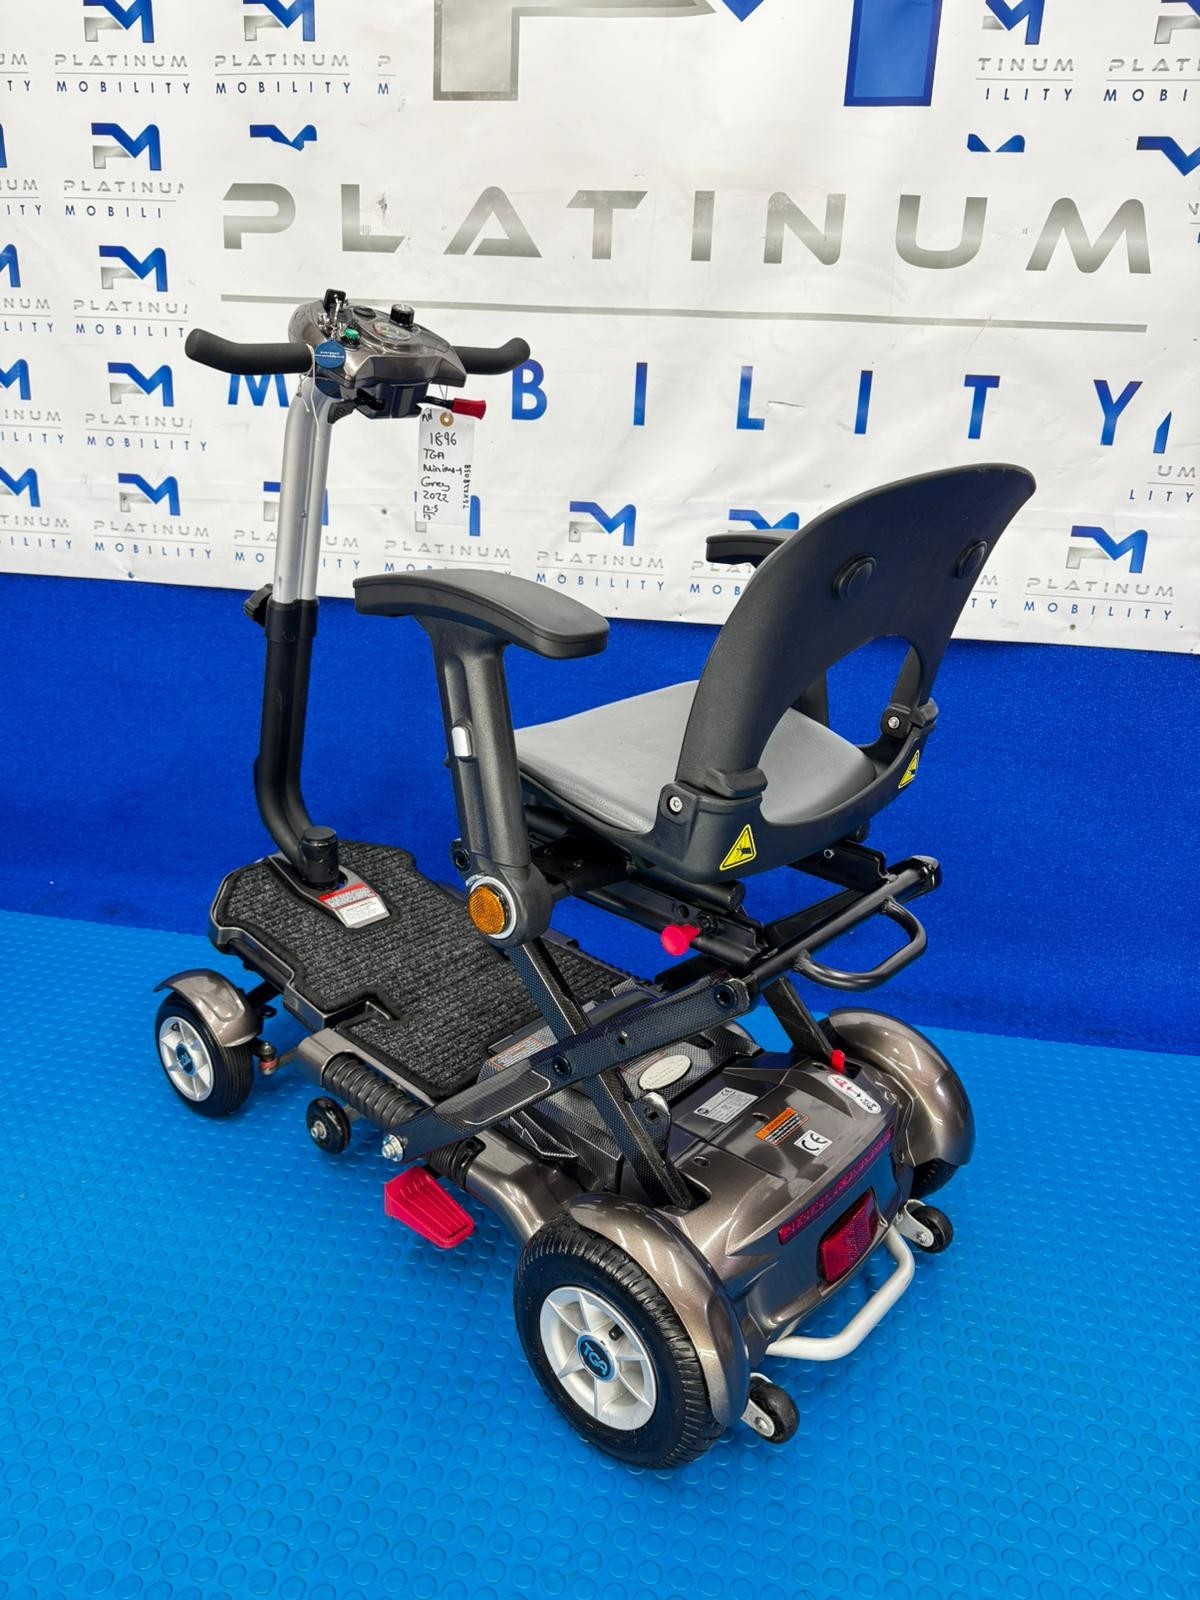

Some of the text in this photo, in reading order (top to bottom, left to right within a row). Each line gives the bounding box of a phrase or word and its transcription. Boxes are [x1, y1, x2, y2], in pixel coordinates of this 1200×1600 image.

[55, 54, 187, 67] PLATINUM
[215, 54, 348, 67] PLATINUM
[57, 81, 190, 94] MOBILITY
[216, 81, 350, 94] MOBILITY
[223, 183, 1151, 273] PLATINUM
[228, 360, 1143, 446] MBILITY
[85, 413, 192, 428] PLATINU
[87, 436, 206, 451] MOBILITY
[429, 432, 457, 446] 1896
[423, 448, 445, 460] TGA
[421, 476, 451, 492] Grey
[423, 490, 449, 503] 2022
[94, 521, 209, 538] PLATINUM
[95, 542, 211, 559] MOBILITY
[385, 541, 512, 559] PLATINUM
[537, 551, 664, 570] PLATINUM
[536, 573, 665, 591] MOBILITY
[1026, 578, 1174, 597] PLATINUM
[1023, 600, 1172, 621] MOBILITY
